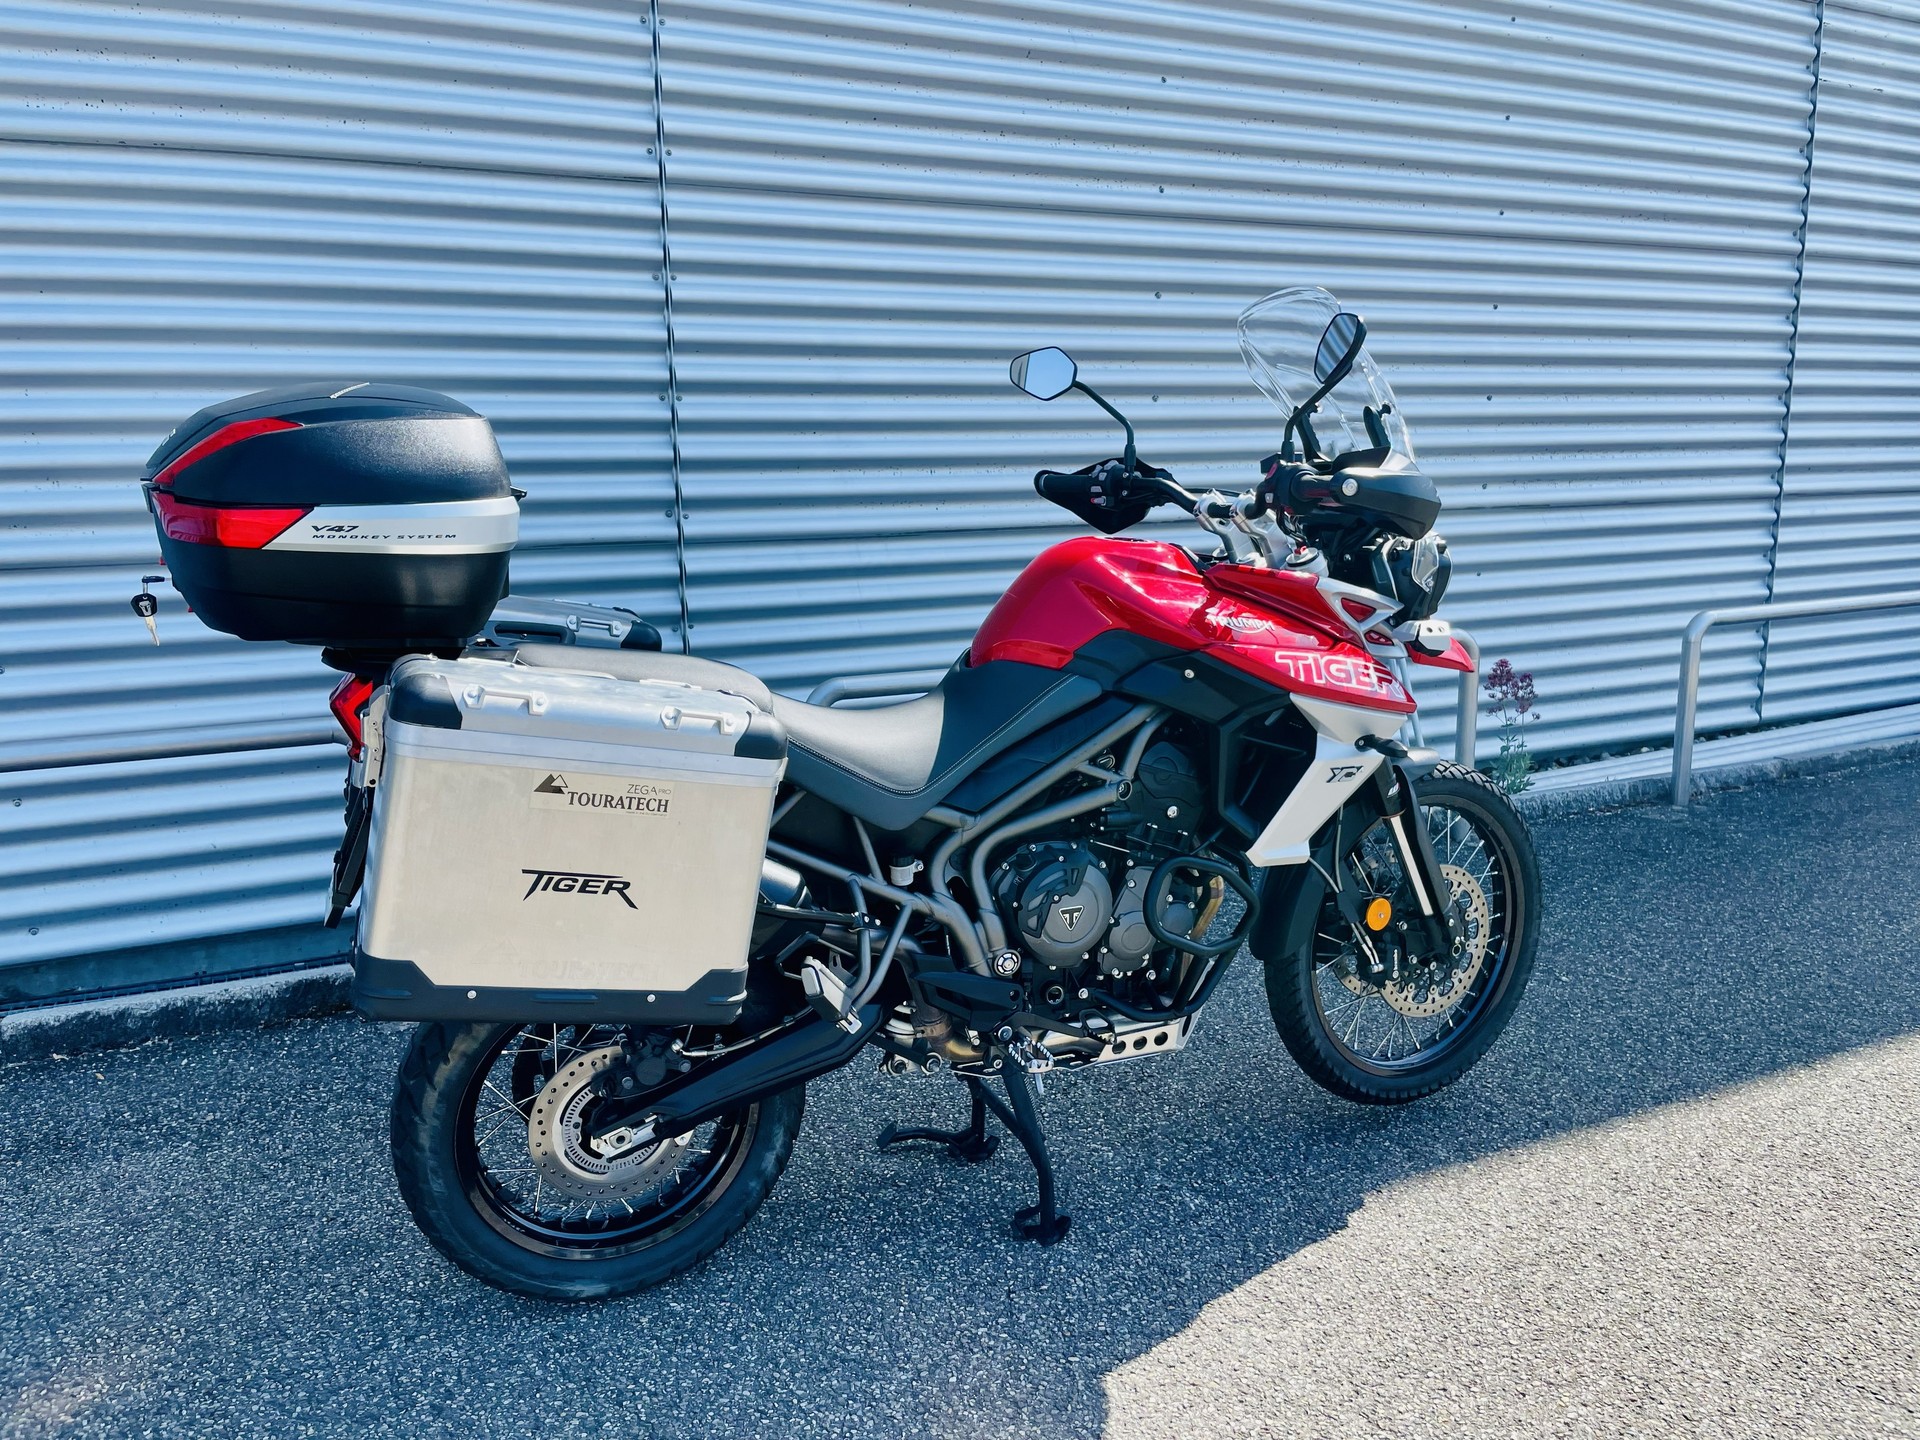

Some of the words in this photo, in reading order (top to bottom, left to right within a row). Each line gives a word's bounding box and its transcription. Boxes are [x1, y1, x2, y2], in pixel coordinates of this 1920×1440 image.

[311, 525, 360, 533] V47
[1275, 651, 1407, 702] TIGER
[626, 783, 658, 796] ZEGA
[567, 791, 669, 813] TOURATECH
[521, 868, 639, 910] TIGER
